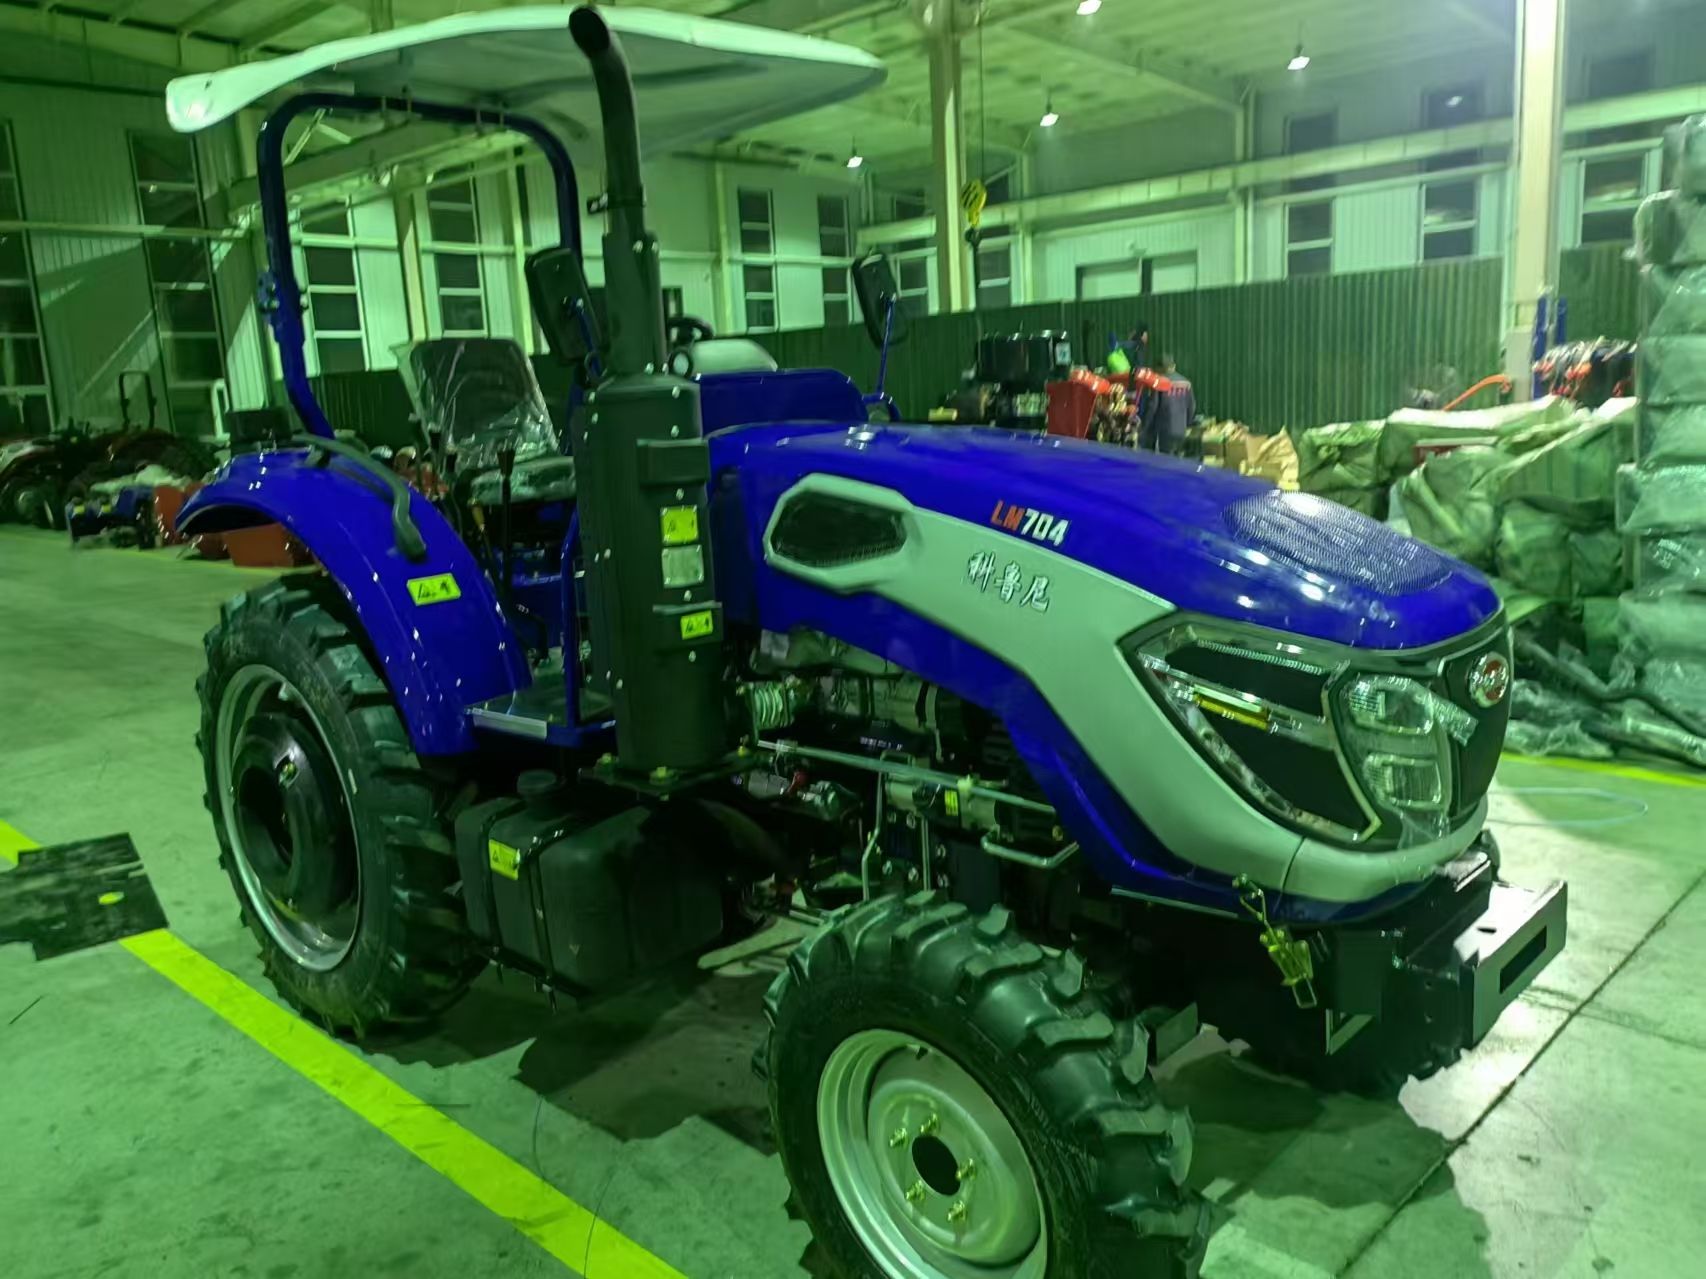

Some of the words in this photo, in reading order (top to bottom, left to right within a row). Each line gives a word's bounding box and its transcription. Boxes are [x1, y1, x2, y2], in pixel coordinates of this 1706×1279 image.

[990, 499, 1070, 547] LM704
[967, 551, 1050, 614] 科鲁尼
